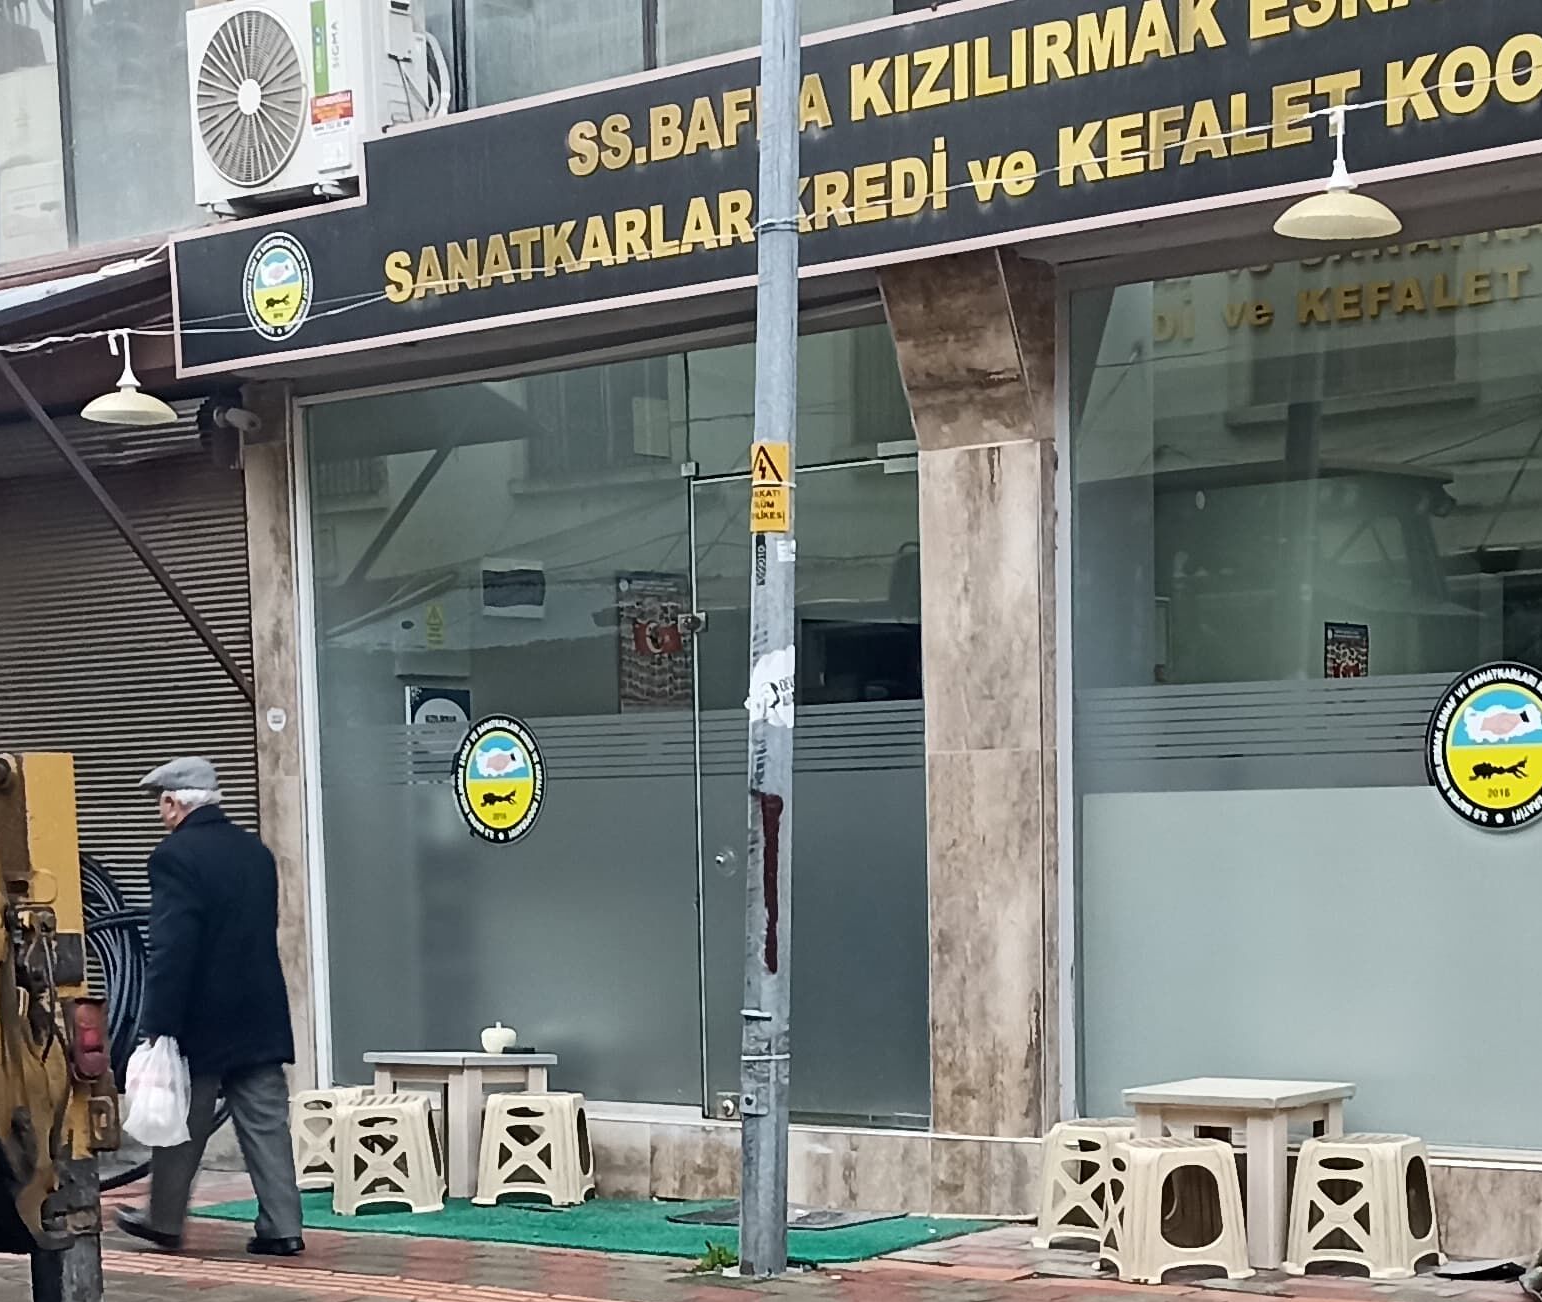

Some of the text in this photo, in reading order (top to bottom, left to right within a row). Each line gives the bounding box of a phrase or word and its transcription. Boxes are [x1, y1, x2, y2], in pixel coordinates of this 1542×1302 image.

[567, 0, 1227, 177] SS.BAFA KIZILIRMAK
[385, 189, 756, 303] SANATKARLAR
[967, 150, 1037, 203] ve
[1058, 69, 1361, 187] KEFALET
[1223, 300, 1274, 328] ve
[1298, 263, 1530, 326] KEFALET
